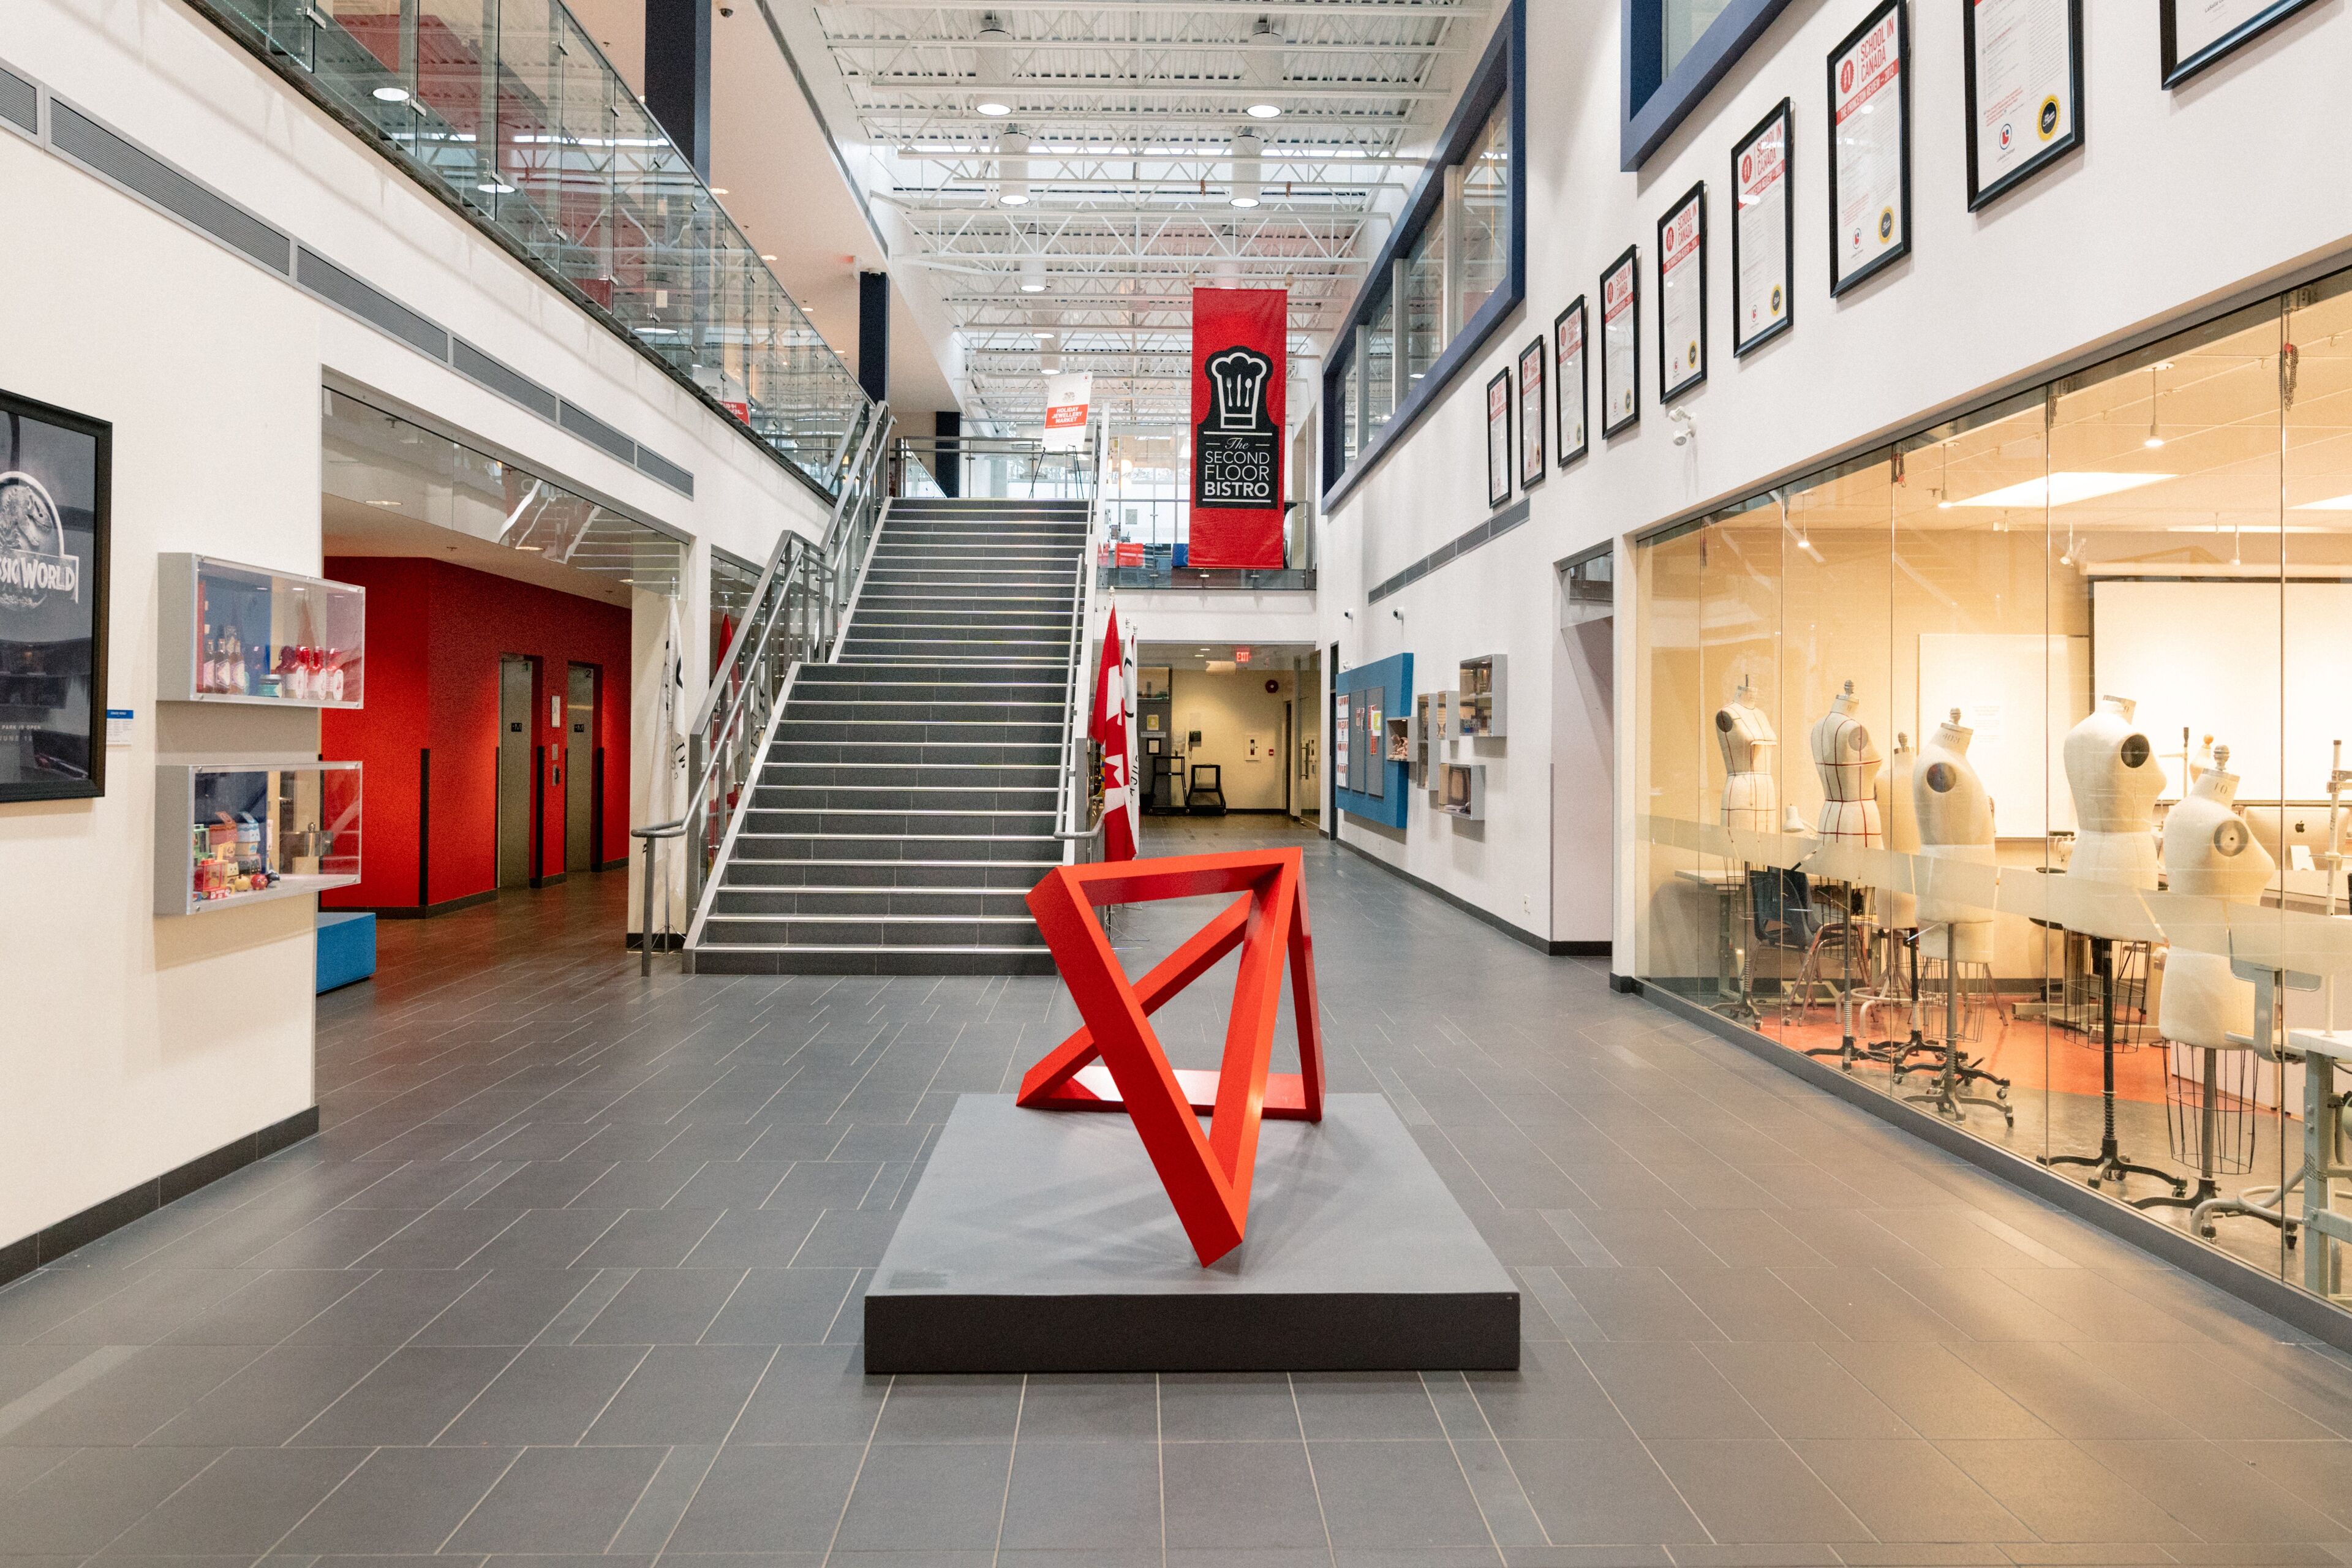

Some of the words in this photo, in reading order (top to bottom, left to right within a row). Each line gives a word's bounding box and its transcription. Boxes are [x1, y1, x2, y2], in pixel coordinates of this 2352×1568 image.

[1861, 25, 1885, 62] SCHOOL
[1887, 15, 1894, 38] IN
[1861, 45, 1886, 82] CANADA
[1844, 63, 1850, 89] #1
[1885, 64, 1894, 81] 2012
[1777, 123, 1781, 140] IN
[1757, 146, 1776, 175] CANADA
[1678, 207, 1692, 230] SCHOOL
[1693, 202, 1696, 217] IN
[1678, 222, 1692, 246] CANADA
[1225, 437, 1250, 449] The
[1205, 451, 1270, 464] SECOND
[1205, 464, 1269, 481] FLOOR
[1205, 481, 1269, 497] BISTRO
[20, 557, 75, 591] WORLD
[1237, 652, 1250, 662] EXIT
[2214, 782, 2228, 794] 10
